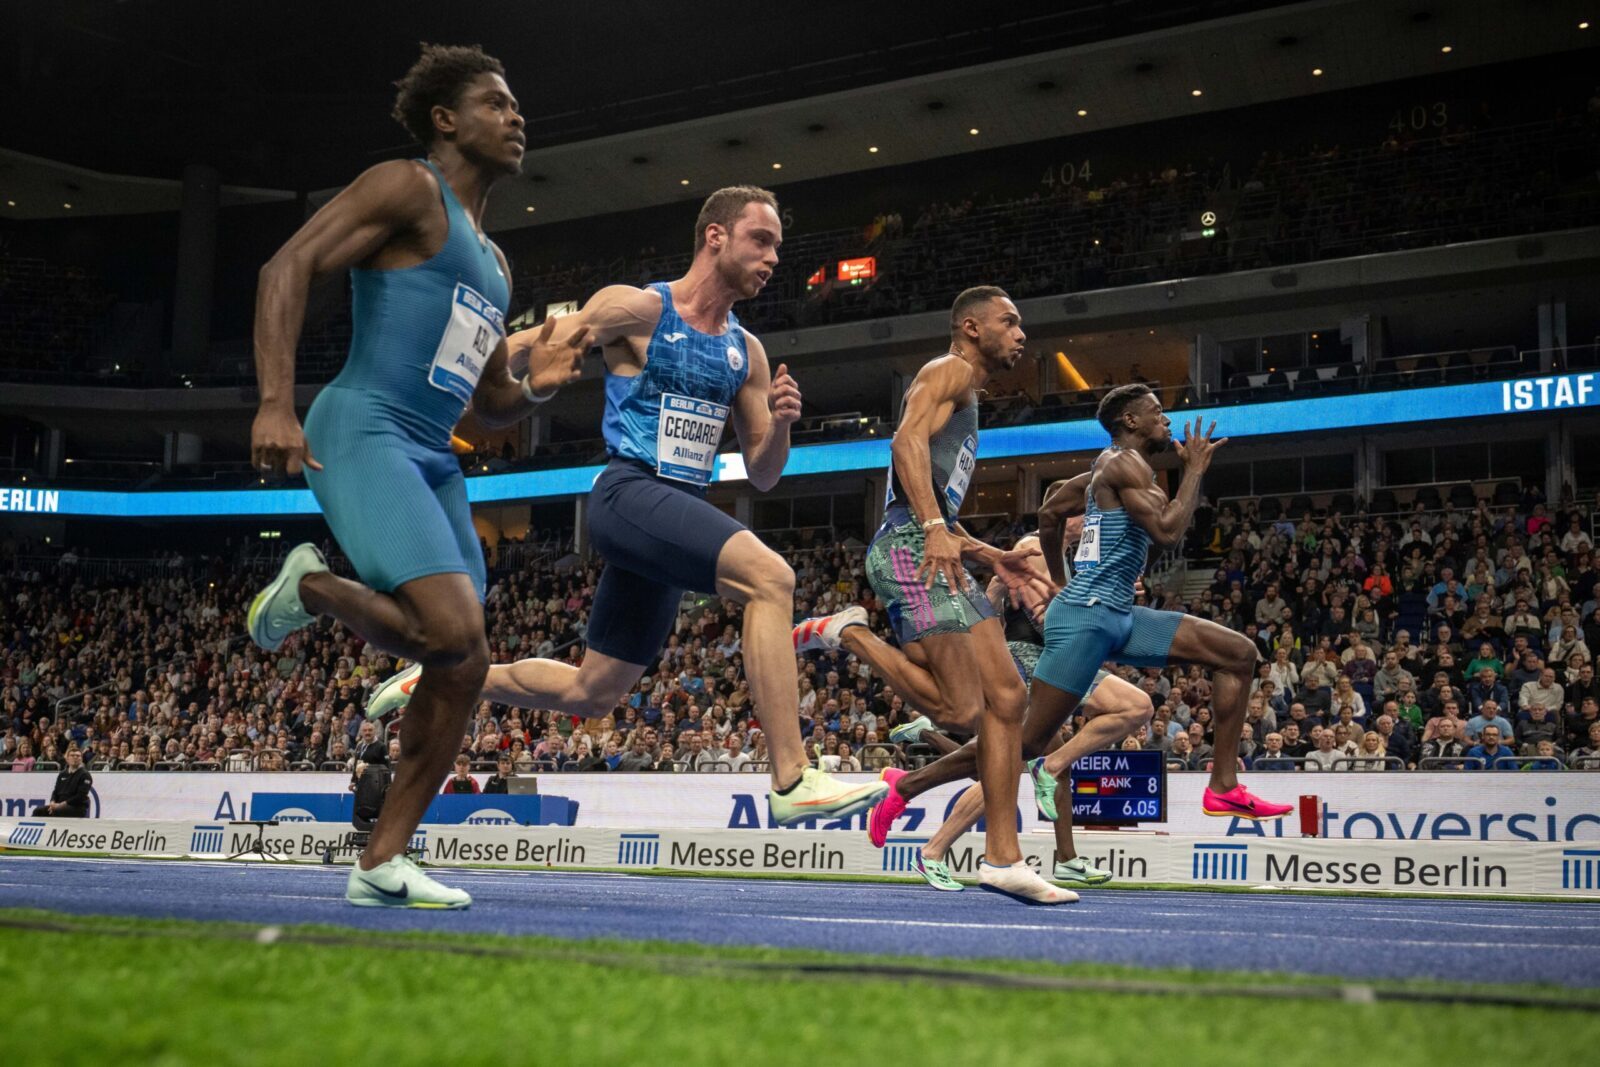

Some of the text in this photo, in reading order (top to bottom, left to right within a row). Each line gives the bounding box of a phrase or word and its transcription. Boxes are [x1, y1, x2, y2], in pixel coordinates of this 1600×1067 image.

[1388, 101, 1448, 134] 403
[1041, 159, 1093, 188] 404
[1503, 374, 1594, 411] ISTAF
[673, 446, 703, 462] Allianz
[0, 488, 59, 512] ERLIN
[1114, 756, 1130, 770] M
[1101, 777, 1158, 794] RANK 8
[1122, 800, 1157, 816] 6.05
[46, 828, 166, 851] Messe Berlin
[435, 837, 586, 863] Messe Berlin
[670, 841, 844, 870] Messe Berlin
[1265, 853, 1507, 888] Messe Berlin
